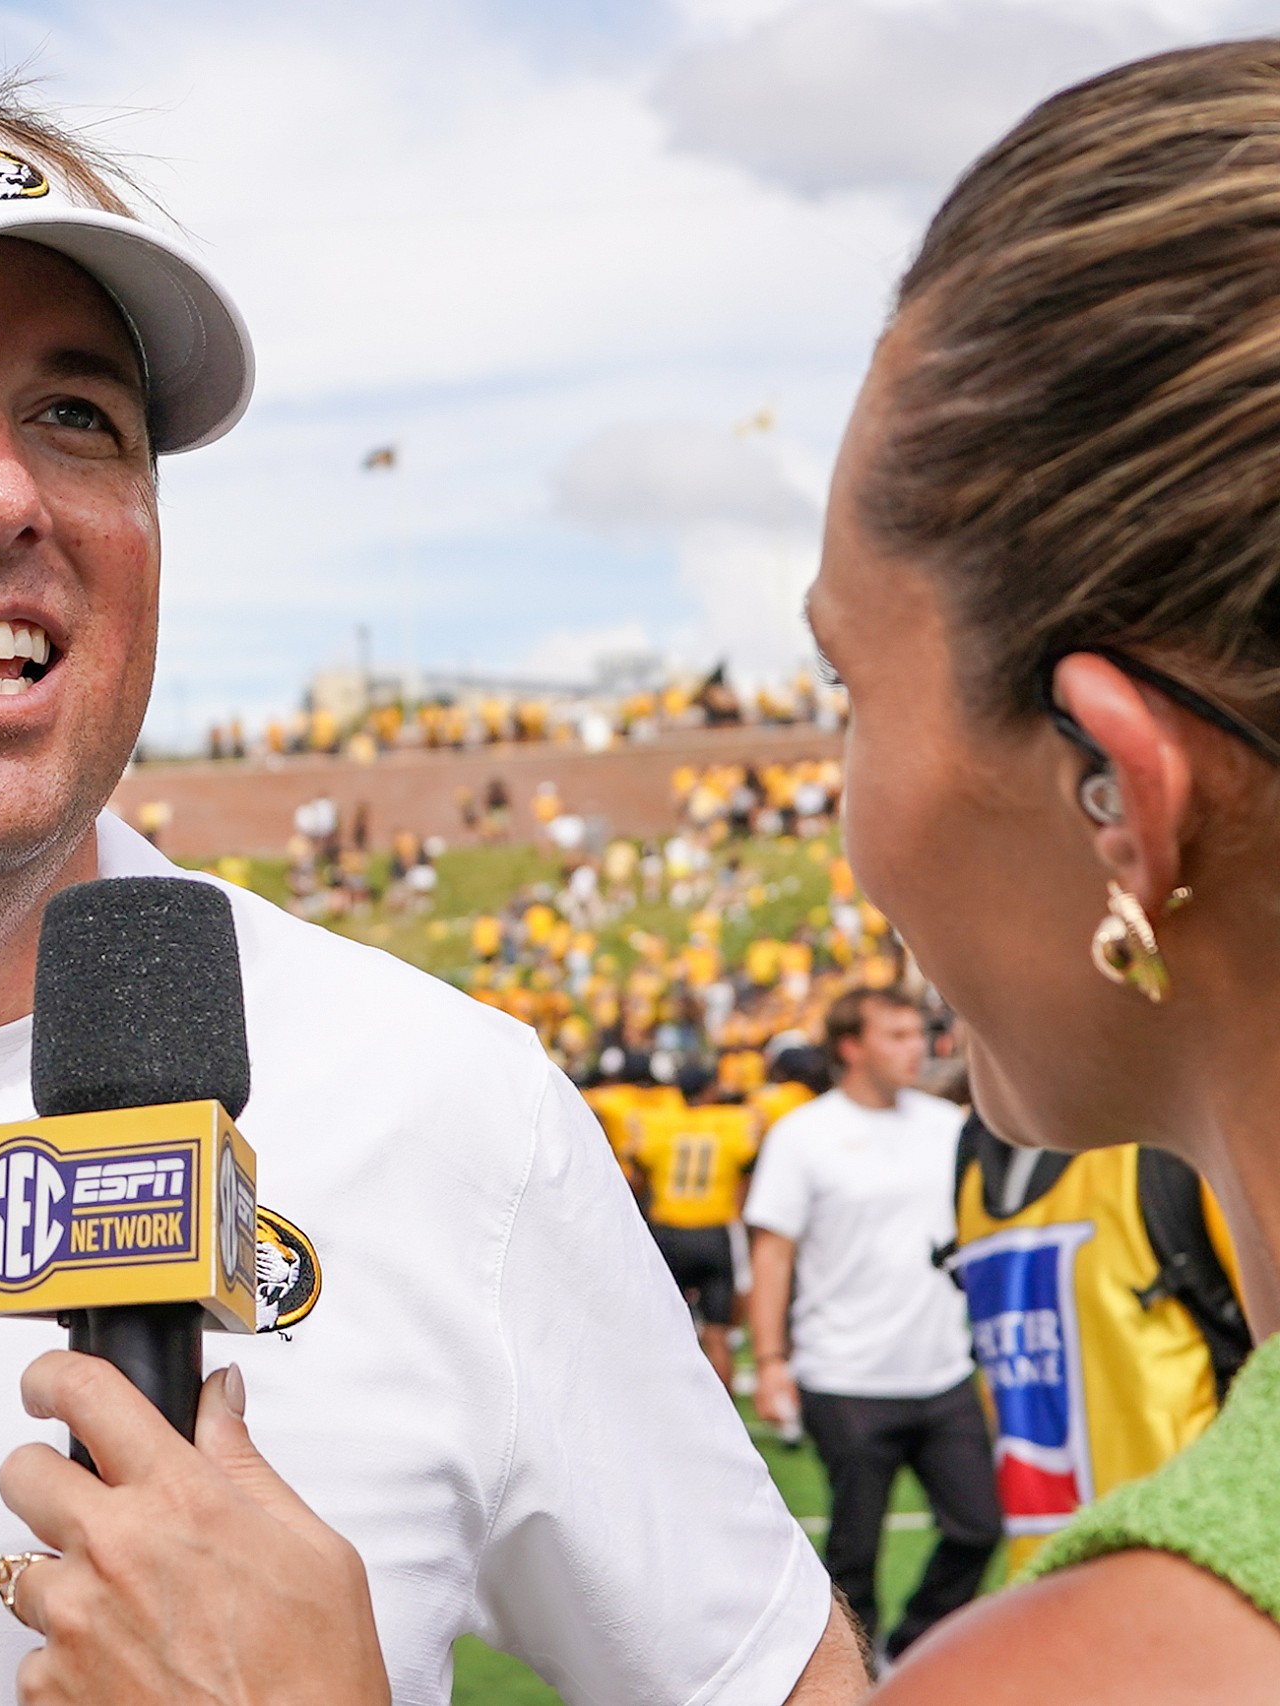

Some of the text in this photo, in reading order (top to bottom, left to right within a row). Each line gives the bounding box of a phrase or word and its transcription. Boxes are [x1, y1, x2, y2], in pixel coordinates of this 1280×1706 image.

[72, 1157, 186, 1205] ESPN
[668, 1133, 719, 1198] 11
[70, 1212, 184, 1253] NETWORK
